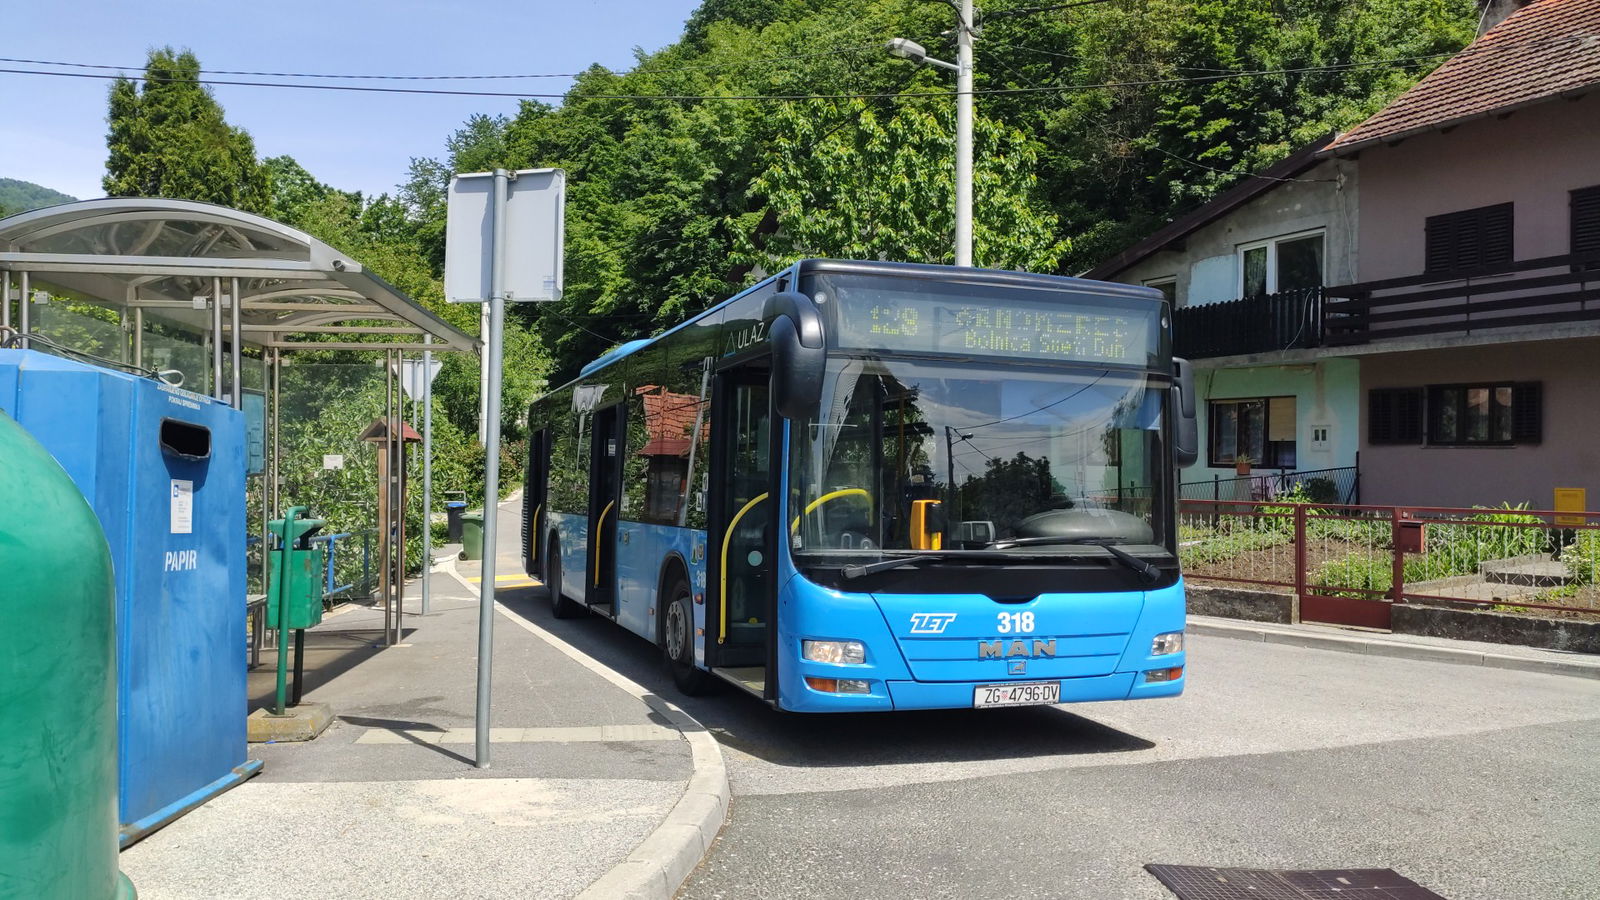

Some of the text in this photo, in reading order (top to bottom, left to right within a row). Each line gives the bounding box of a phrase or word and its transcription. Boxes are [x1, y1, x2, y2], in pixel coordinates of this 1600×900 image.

[737, 321, 765, 349] ULAZ
[164, 549, 197, 572] PAPIR
[909, 613, 958, 634] ZET
[997, 611, 1035, 634] 318
[978, 639, 1057, 661] MAN
[984, 687, 1001, 704] ZG
